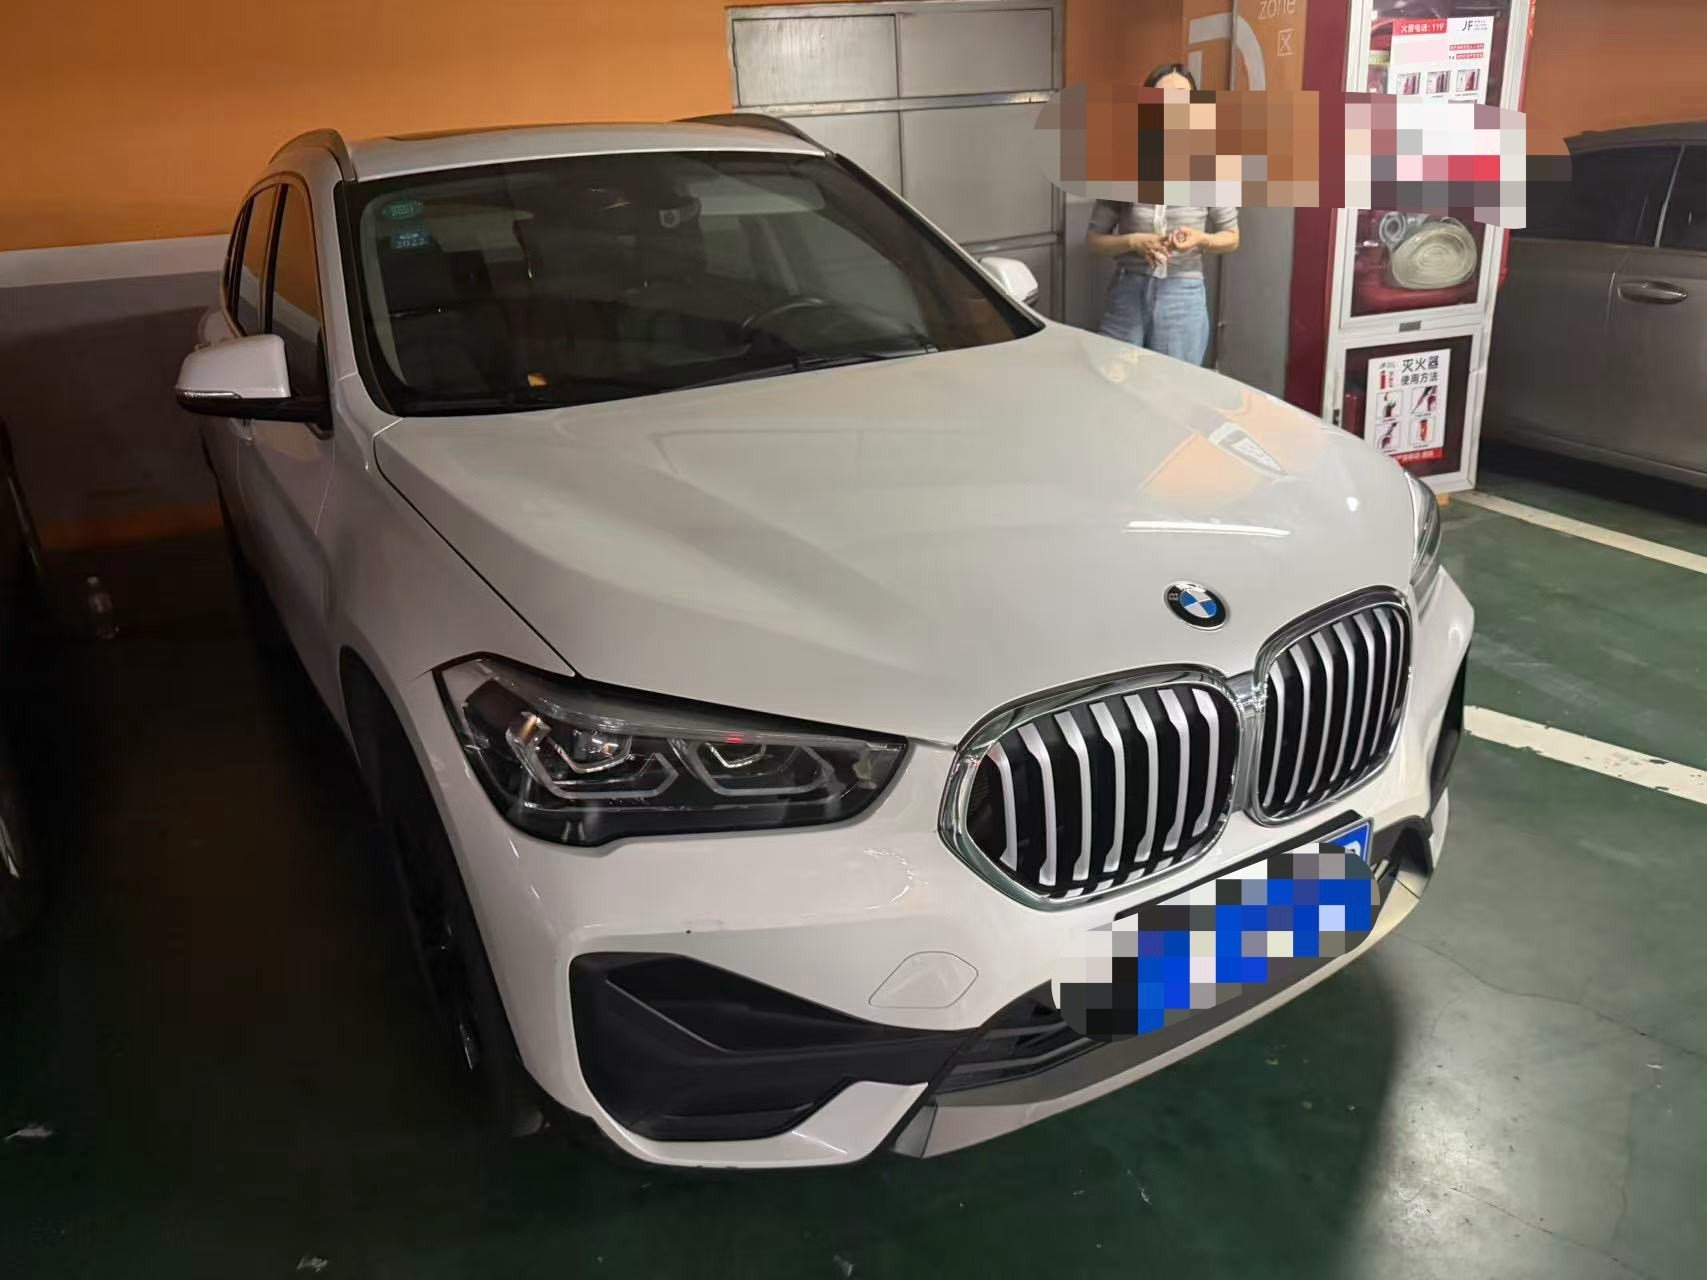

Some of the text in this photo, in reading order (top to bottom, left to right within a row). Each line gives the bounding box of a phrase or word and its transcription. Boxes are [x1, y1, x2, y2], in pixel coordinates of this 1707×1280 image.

[1258, 0, 1296, 20] zone
[1402, 355, 1439, 373] 灭火器
[1400, 371, 1438, 386] 使用方法
